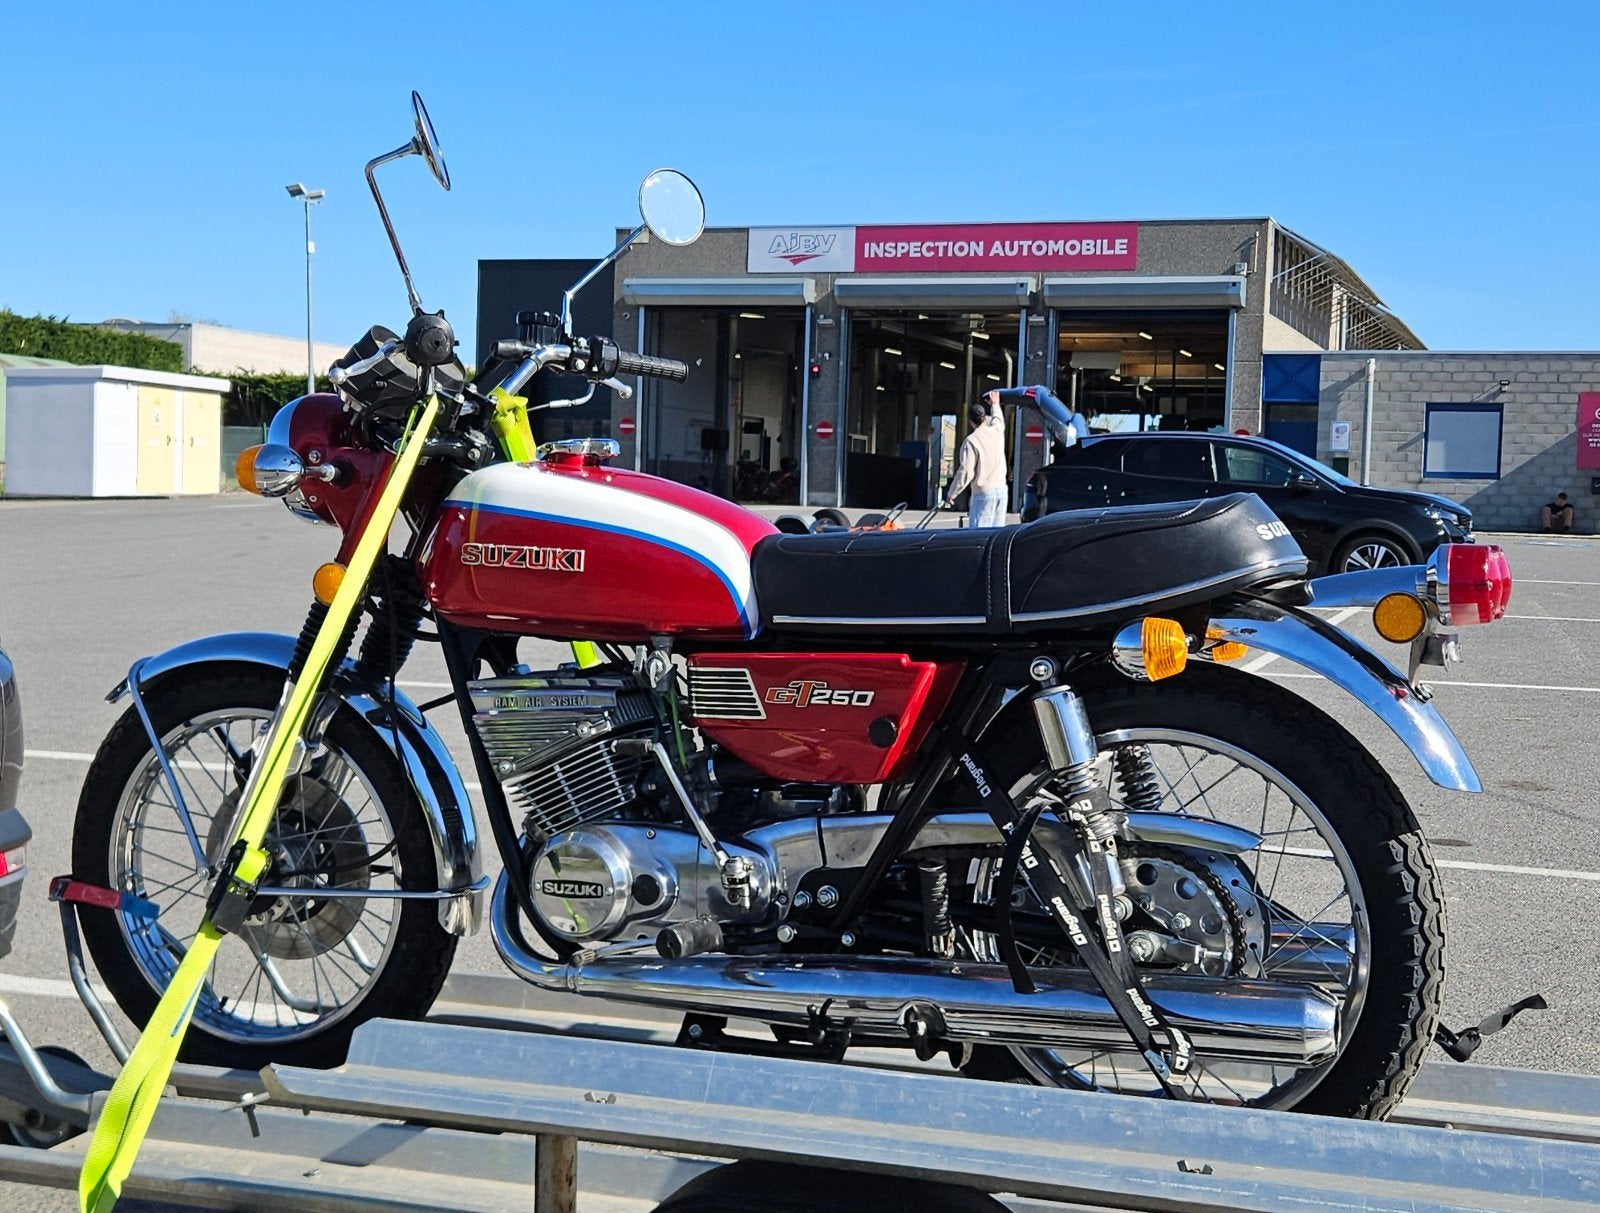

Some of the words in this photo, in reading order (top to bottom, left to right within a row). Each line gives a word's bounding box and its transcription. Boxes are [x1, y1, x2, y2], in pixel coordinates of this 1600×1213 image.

[864, 241, 983, 258] INSPECTION
[989, 239, 1128, 257] AUTOMOBILE
[461, 543, 585, 572] SUZUKI
[495, 697, 519, 708] RAM
[525, 696, 542, 707] AIR
[550, 695, 587, 706] SYSTEM
[543, 882, 602, 896] SUZUKI
